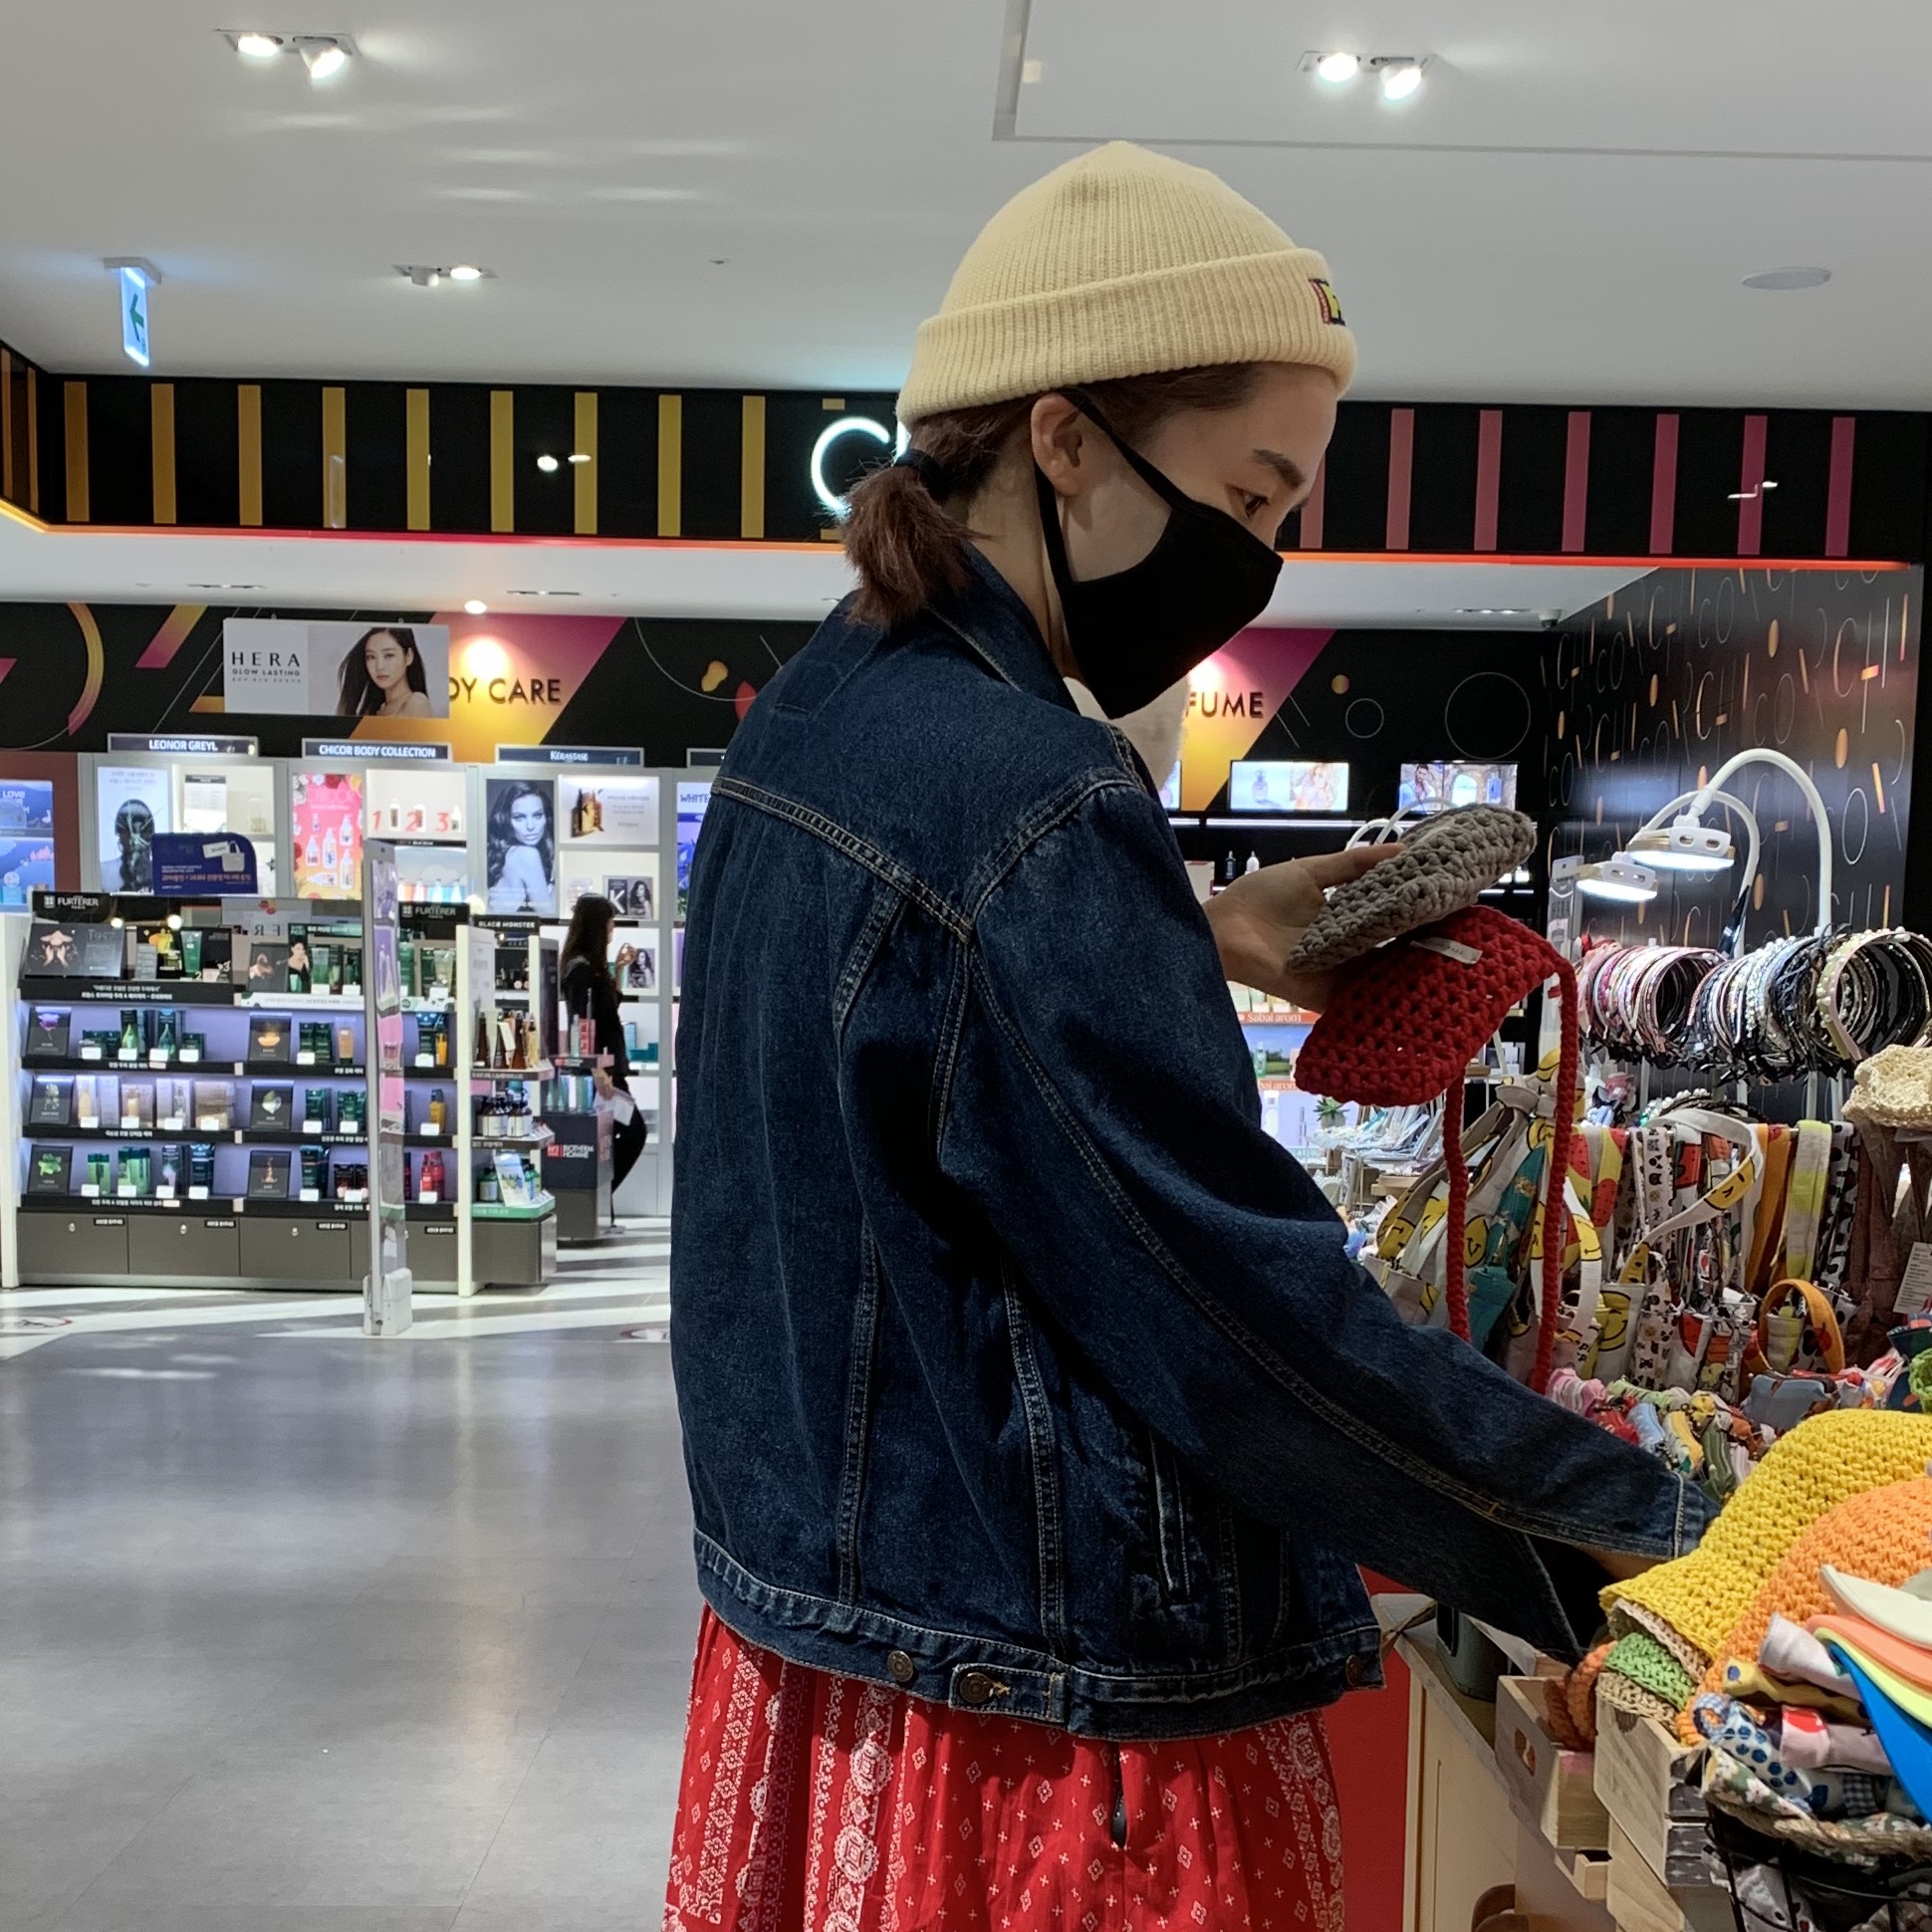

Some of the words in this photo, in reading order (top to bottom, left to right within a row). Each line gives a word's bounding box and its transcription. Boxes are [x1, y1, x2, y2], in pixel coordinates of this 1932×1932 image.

[231, 651, 301, 667] HERA
[449, 677, 477, 703] DY
[489, 677, 562, 705] CARE
[1185, 691, 1264, 719] FUME
[149, 739, 187, 751] LEONOR
[188, 740, 218, 752] GREYL
[319, 745, 353, 756] CHICOR
[355, 745, 379, 757] BODY
[380, 747, 436, 758] COLLECTION
[57, 896, 99, 906] FURTERER
[414, 906, 456, 916] FURTERER
[1247, 1011, 1275, 1023] Sabal
[1275, 1012, 1303, 1023] arom
